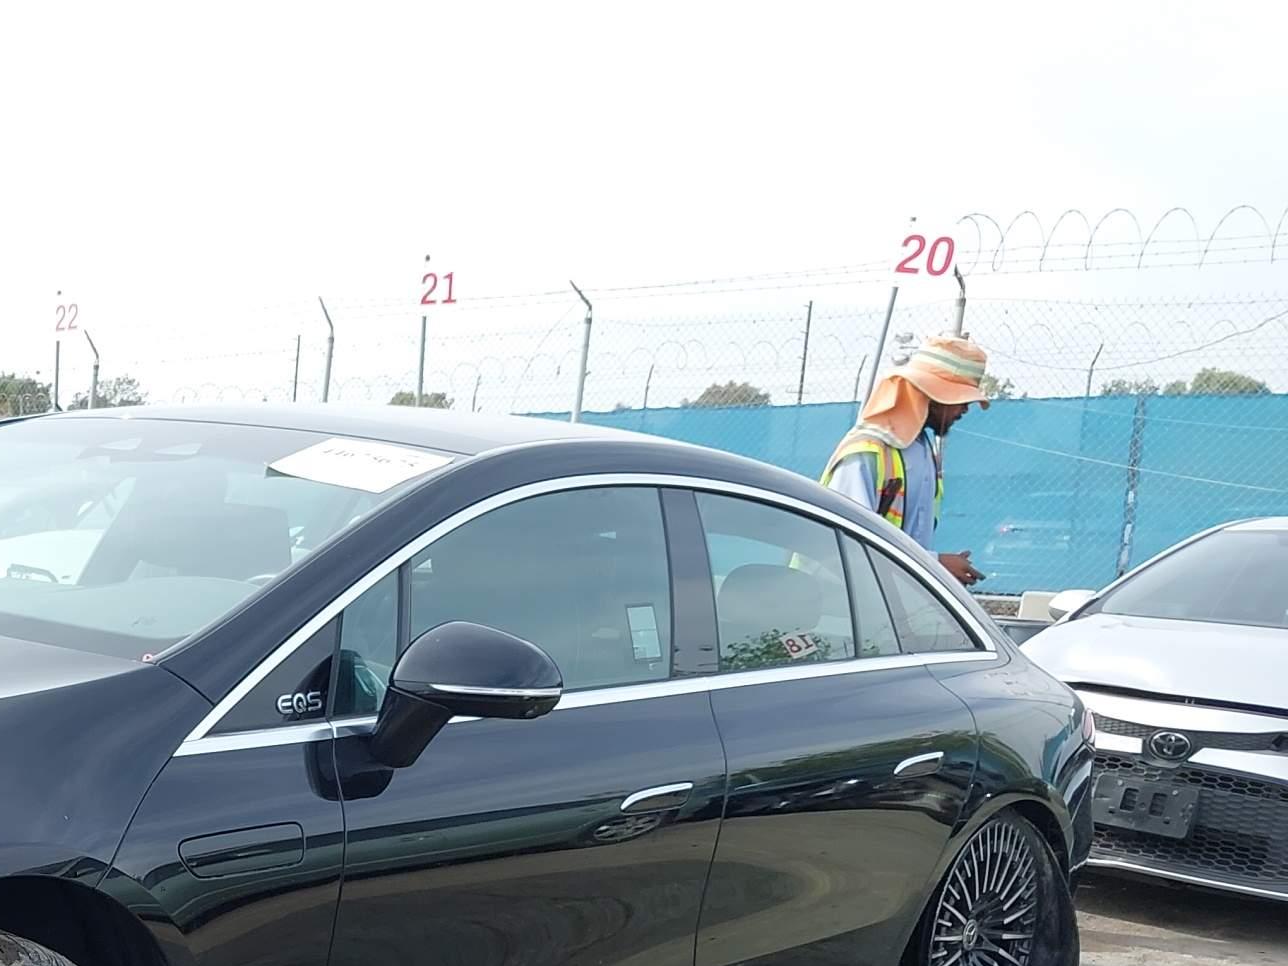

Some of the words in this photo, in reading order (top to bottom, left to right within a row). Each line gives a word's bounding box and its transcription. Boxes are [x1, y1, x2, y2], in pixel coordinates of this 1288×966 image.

[895, 234, 954, 277] 20
[420, 271, 456, 305] 21
[56, 303, 78, 332] 22
[277, 691, 322, 715] EQS
